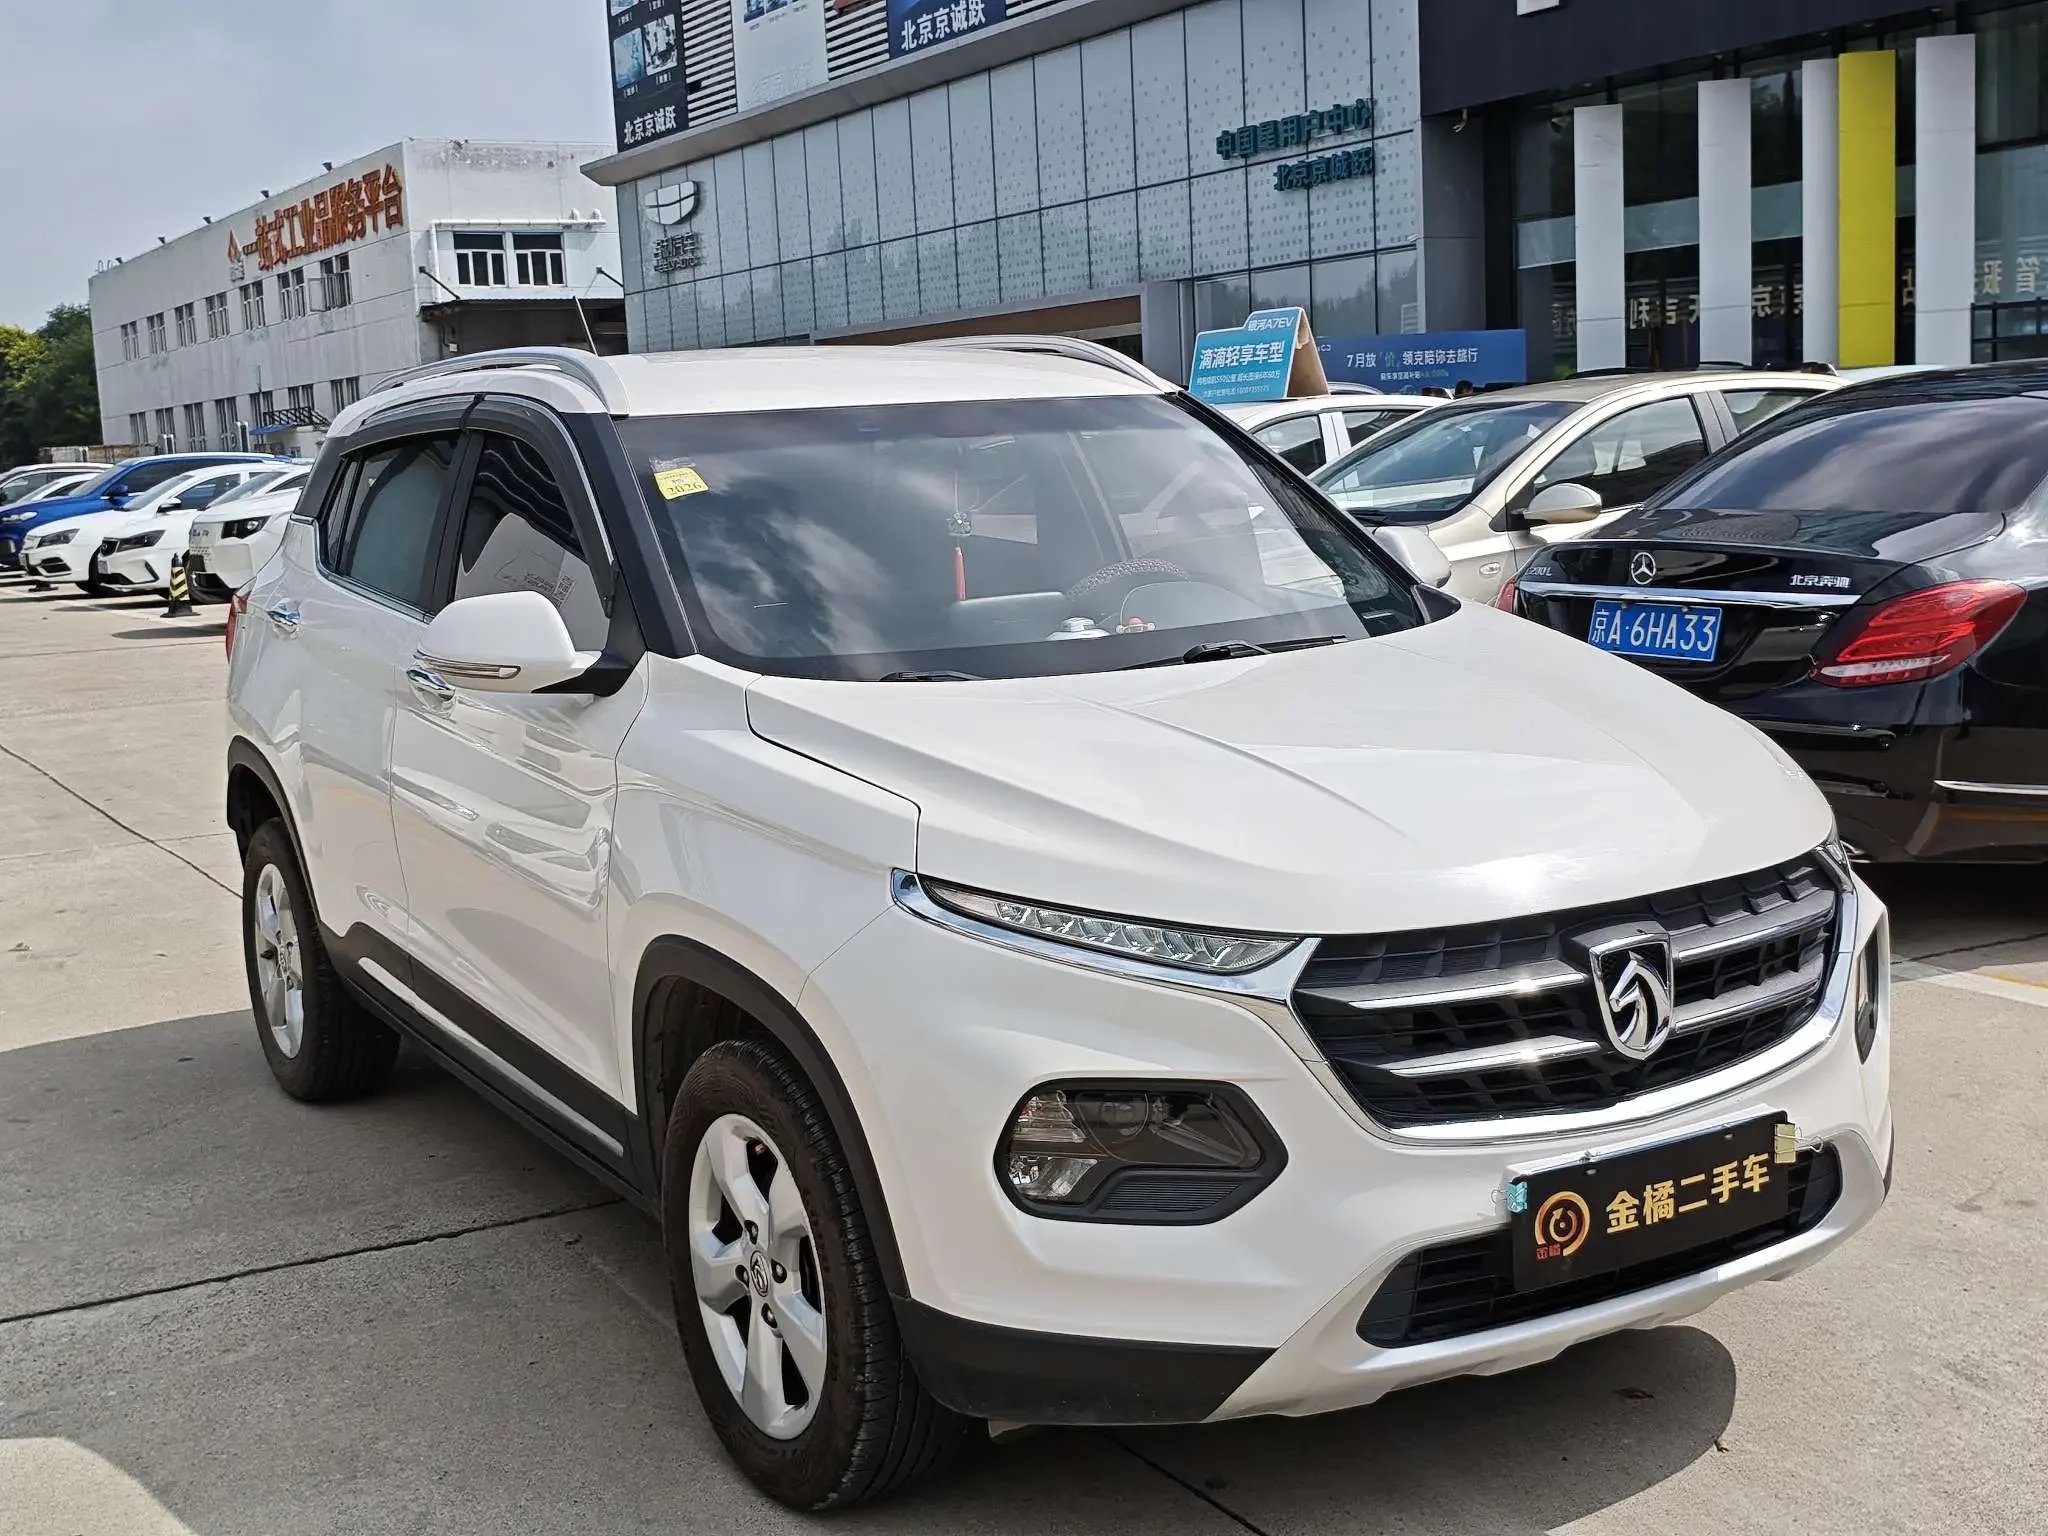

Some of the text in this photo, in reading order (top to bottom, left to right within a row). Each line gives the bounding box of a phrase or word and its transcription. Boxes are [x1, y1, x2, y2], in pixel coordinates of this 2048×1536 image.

[624, 105, 676, 145] 北京京诚跃
[1199, 338, 1286, 370] 滴滴轻享车型
[1789, 574, 1850, 588] 北京奔驰
[1606, 1152, 1770, 1234] 金橘二手车
